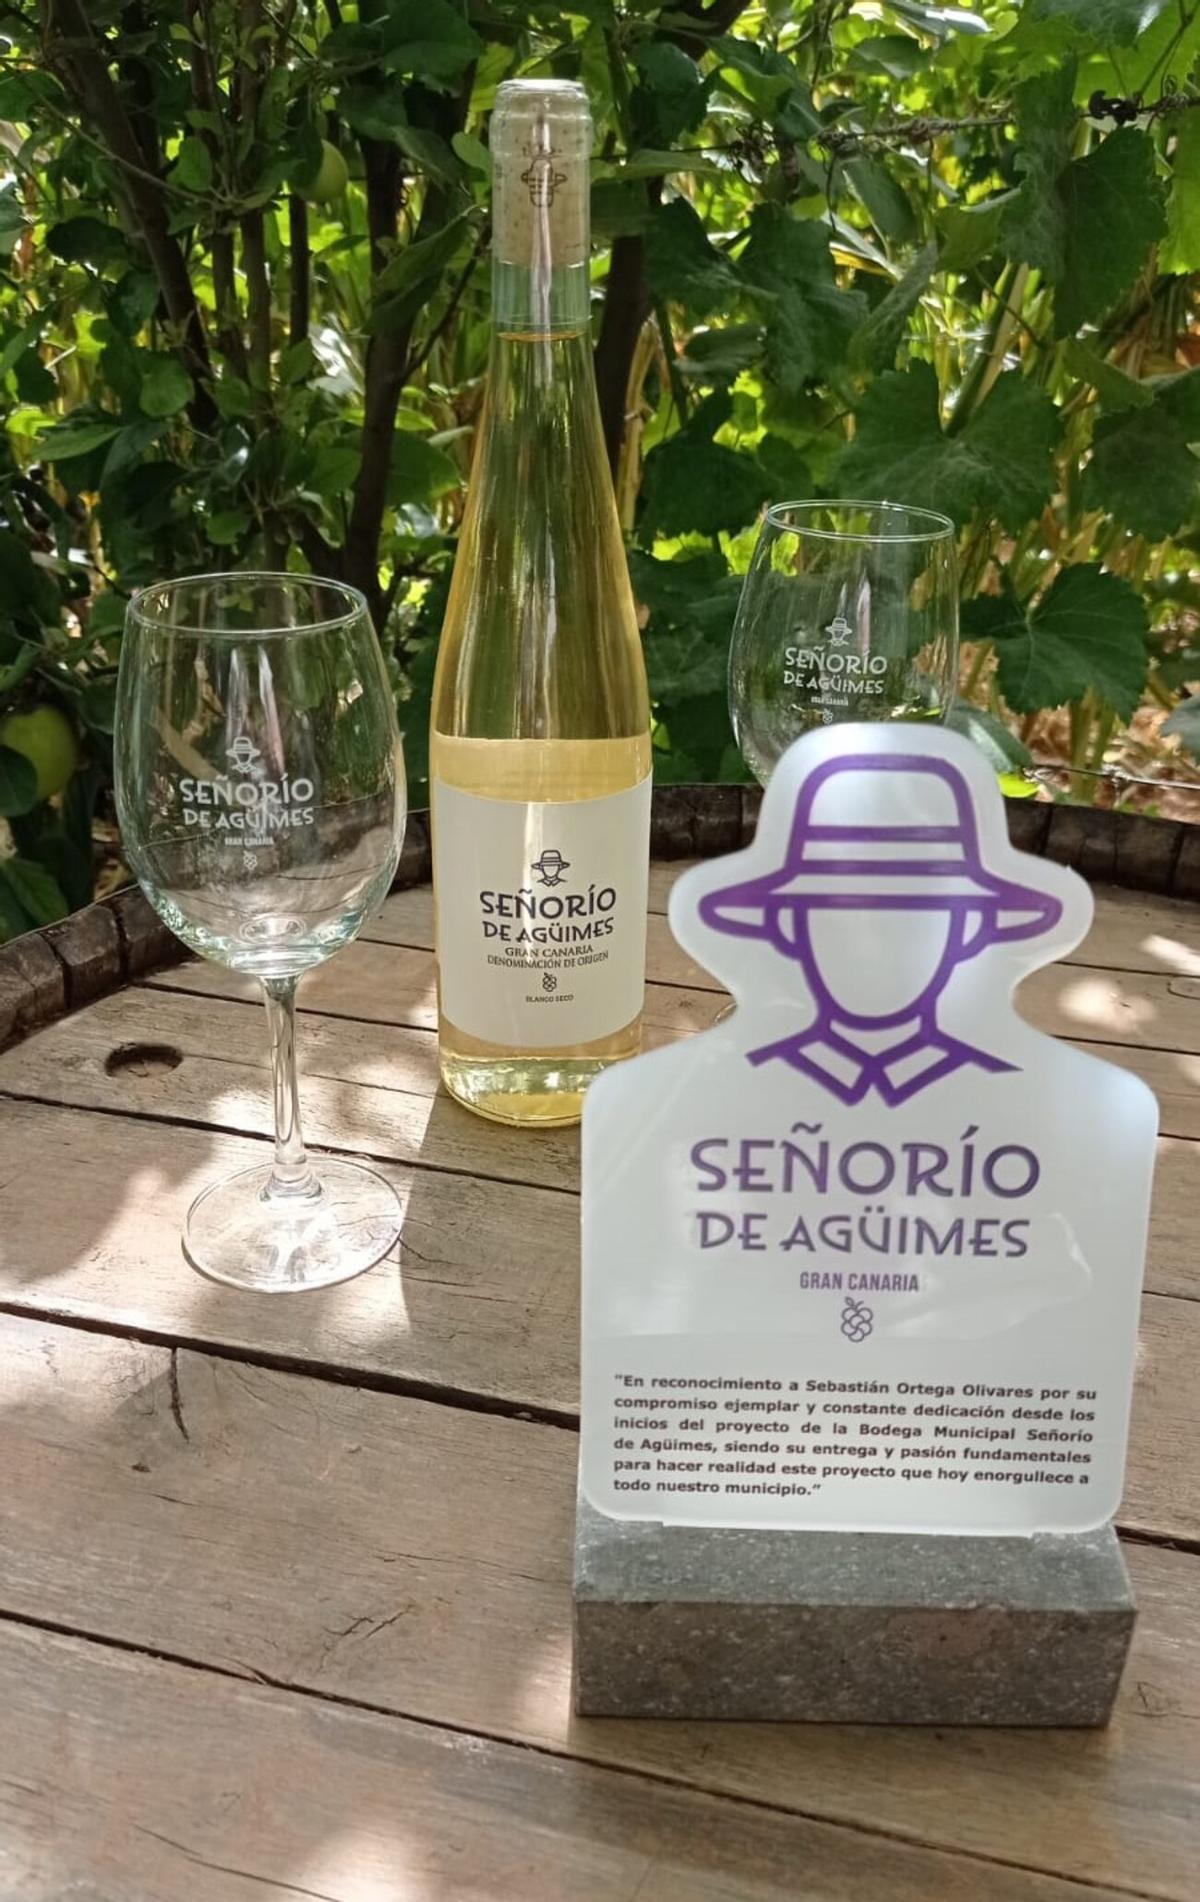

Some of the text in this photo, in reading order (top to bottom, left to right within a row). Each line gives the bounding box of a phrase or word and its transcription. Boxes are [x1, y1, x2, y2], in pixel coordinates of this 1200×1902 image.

[785, 645, 887, 675] SEÑORÍO
[784, 670, 884, 694] DE AGÜIMES
[179, 773, 314, 806] SEÑORÍO
[183, 808, 211, 828] DE
[480, 884, 616, 919] SEÑORÍO
[482, 917, 614, 943] DE AGÜIMES
[487, 954, 560, 969] DENOMINACIÓN
[577, 950, 608, 966] ORIGEN
[505, 944, 593, 958] GRAN CANARIA
[691, 1122, 1040, 1198] SEÑORÍO
[696, 1206, 1030, 1258] DE AGÜIMES
[800, 1271, 919, 1292] GRAN CANARIA
[651, 1377, 782, 1391] reconocimiento
[789, 1381, 799, 1391] a
[805, 1379, 889, 1394] Sebastián
[897, 1382, 955, 1398] Ortega
[962, 1383, 1034, 1398] Olivares
[1040, 1387, 1070, 1400] por
[1076, 1389, 1097, 1400] su
[614, 1397, 1095, 1421] compromiso ejemplar y constante dedicación desde los
[614, 1416, 1093, 1442] inicios del proyecto de la Bodega Municipal Señorío
[614, 1437, 1092, 1463] de Agüimes, siendo su entrega y pasión fundamentales
[613, 1459, 1089, 1484] para hacer realidad este proyecto que hoy enorgullece a
[613, 1479, 650, 1491] todo
[657, 1480, 720, 1493] nuestro
